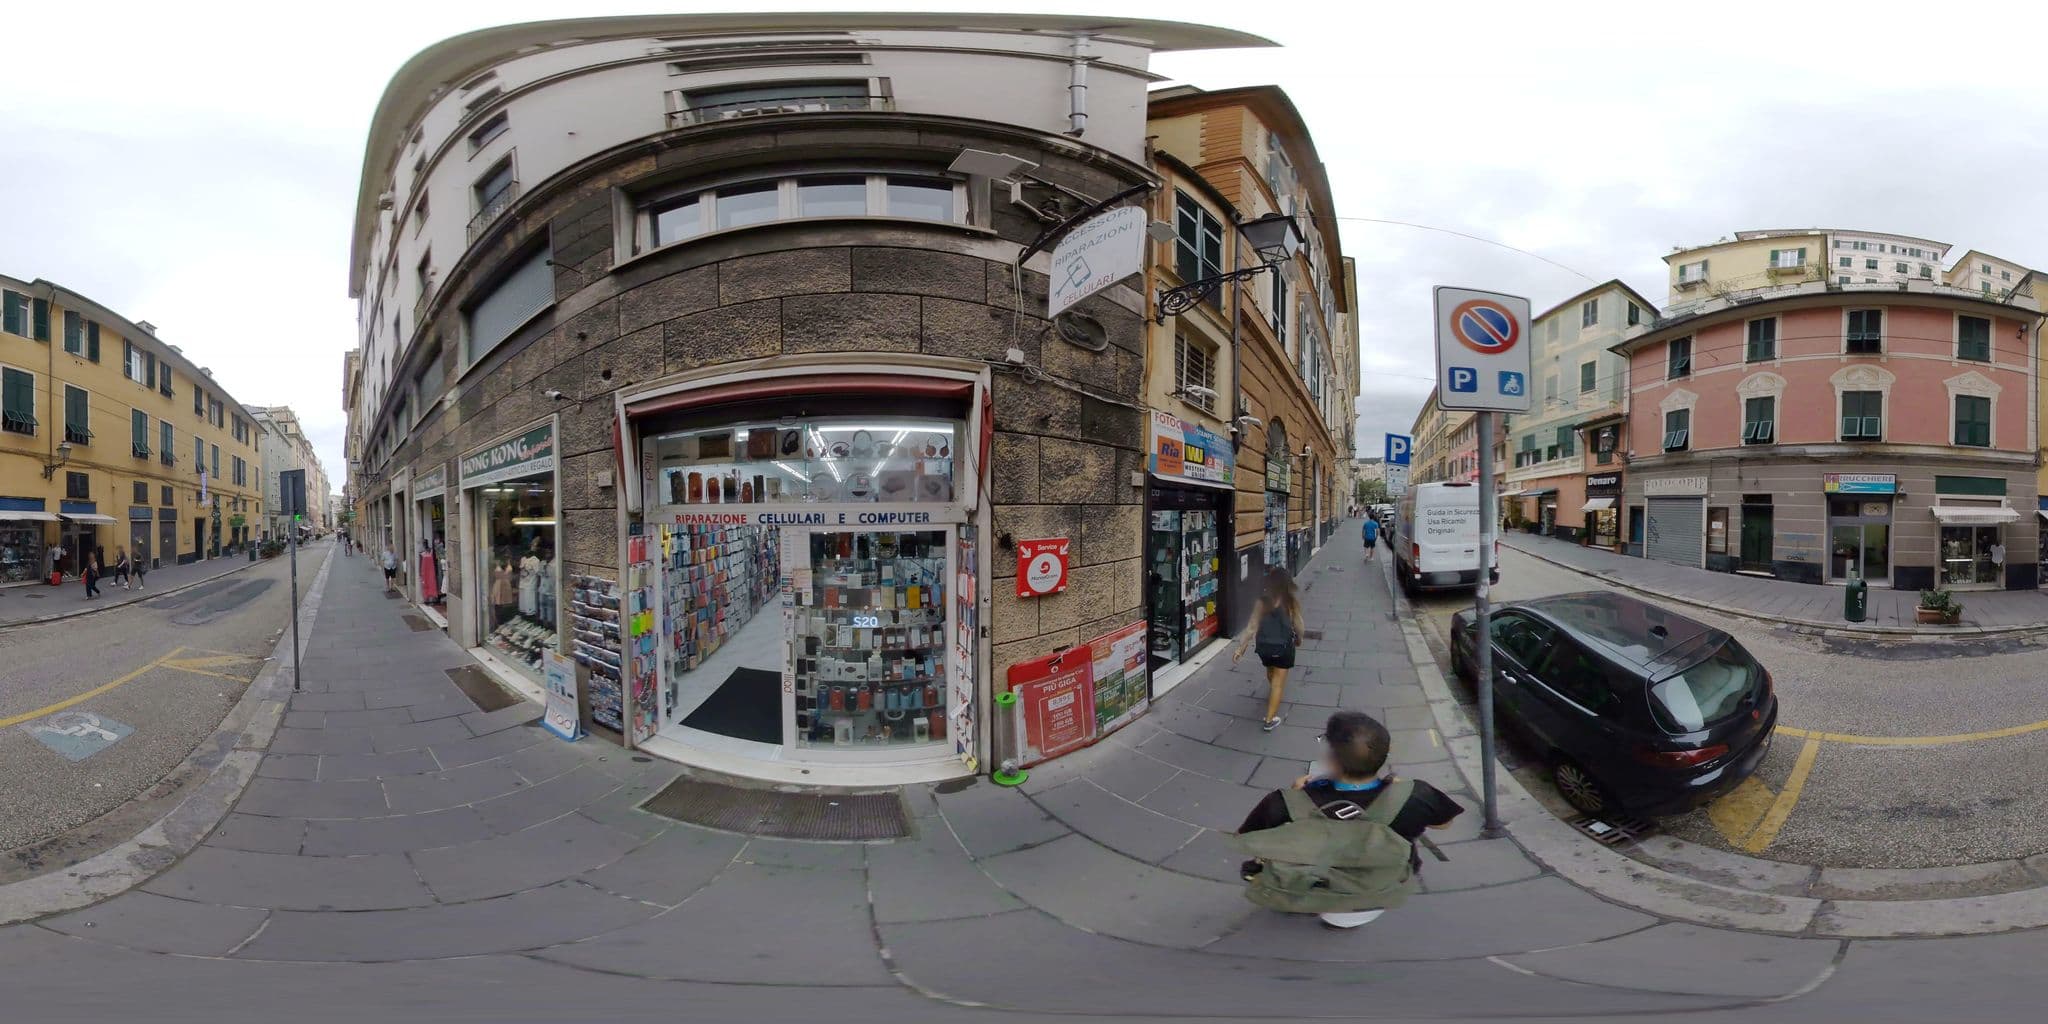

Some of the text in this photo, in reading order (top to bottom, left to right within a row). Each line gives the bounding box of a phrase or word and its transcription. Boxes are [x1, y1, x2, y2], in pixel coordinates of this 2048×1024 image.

[1057, 207, 1133, 248] ACCESSORI
[1055, 223, 1133, 267] RIPARAZIONI
[1063, 272, 1115, 306] CELLULARI
[1454, 369, 1471, 389] P
[463, 437, 527, 475] HONG KONG
[1161, 443, 1179, 458] Ria
[1391, 437, 1407, 461] P
[530, 456, 553, 471] REGALO
[1185, 464, 1205, 473] WESTERN
[1588, 477, 1616, 486] Denaro
[675, 512, 930, 524] RIPARAZIONE CELLULARI E COMPUTER
[1454, 508, 1480, 516] Sicurezz
[1428, 527, 1455, 536] Originali
[854, 616, 878, 628] S20
[784, 674, 794, 694] iliad
[1058, 676, 1076, 689] GIGA
